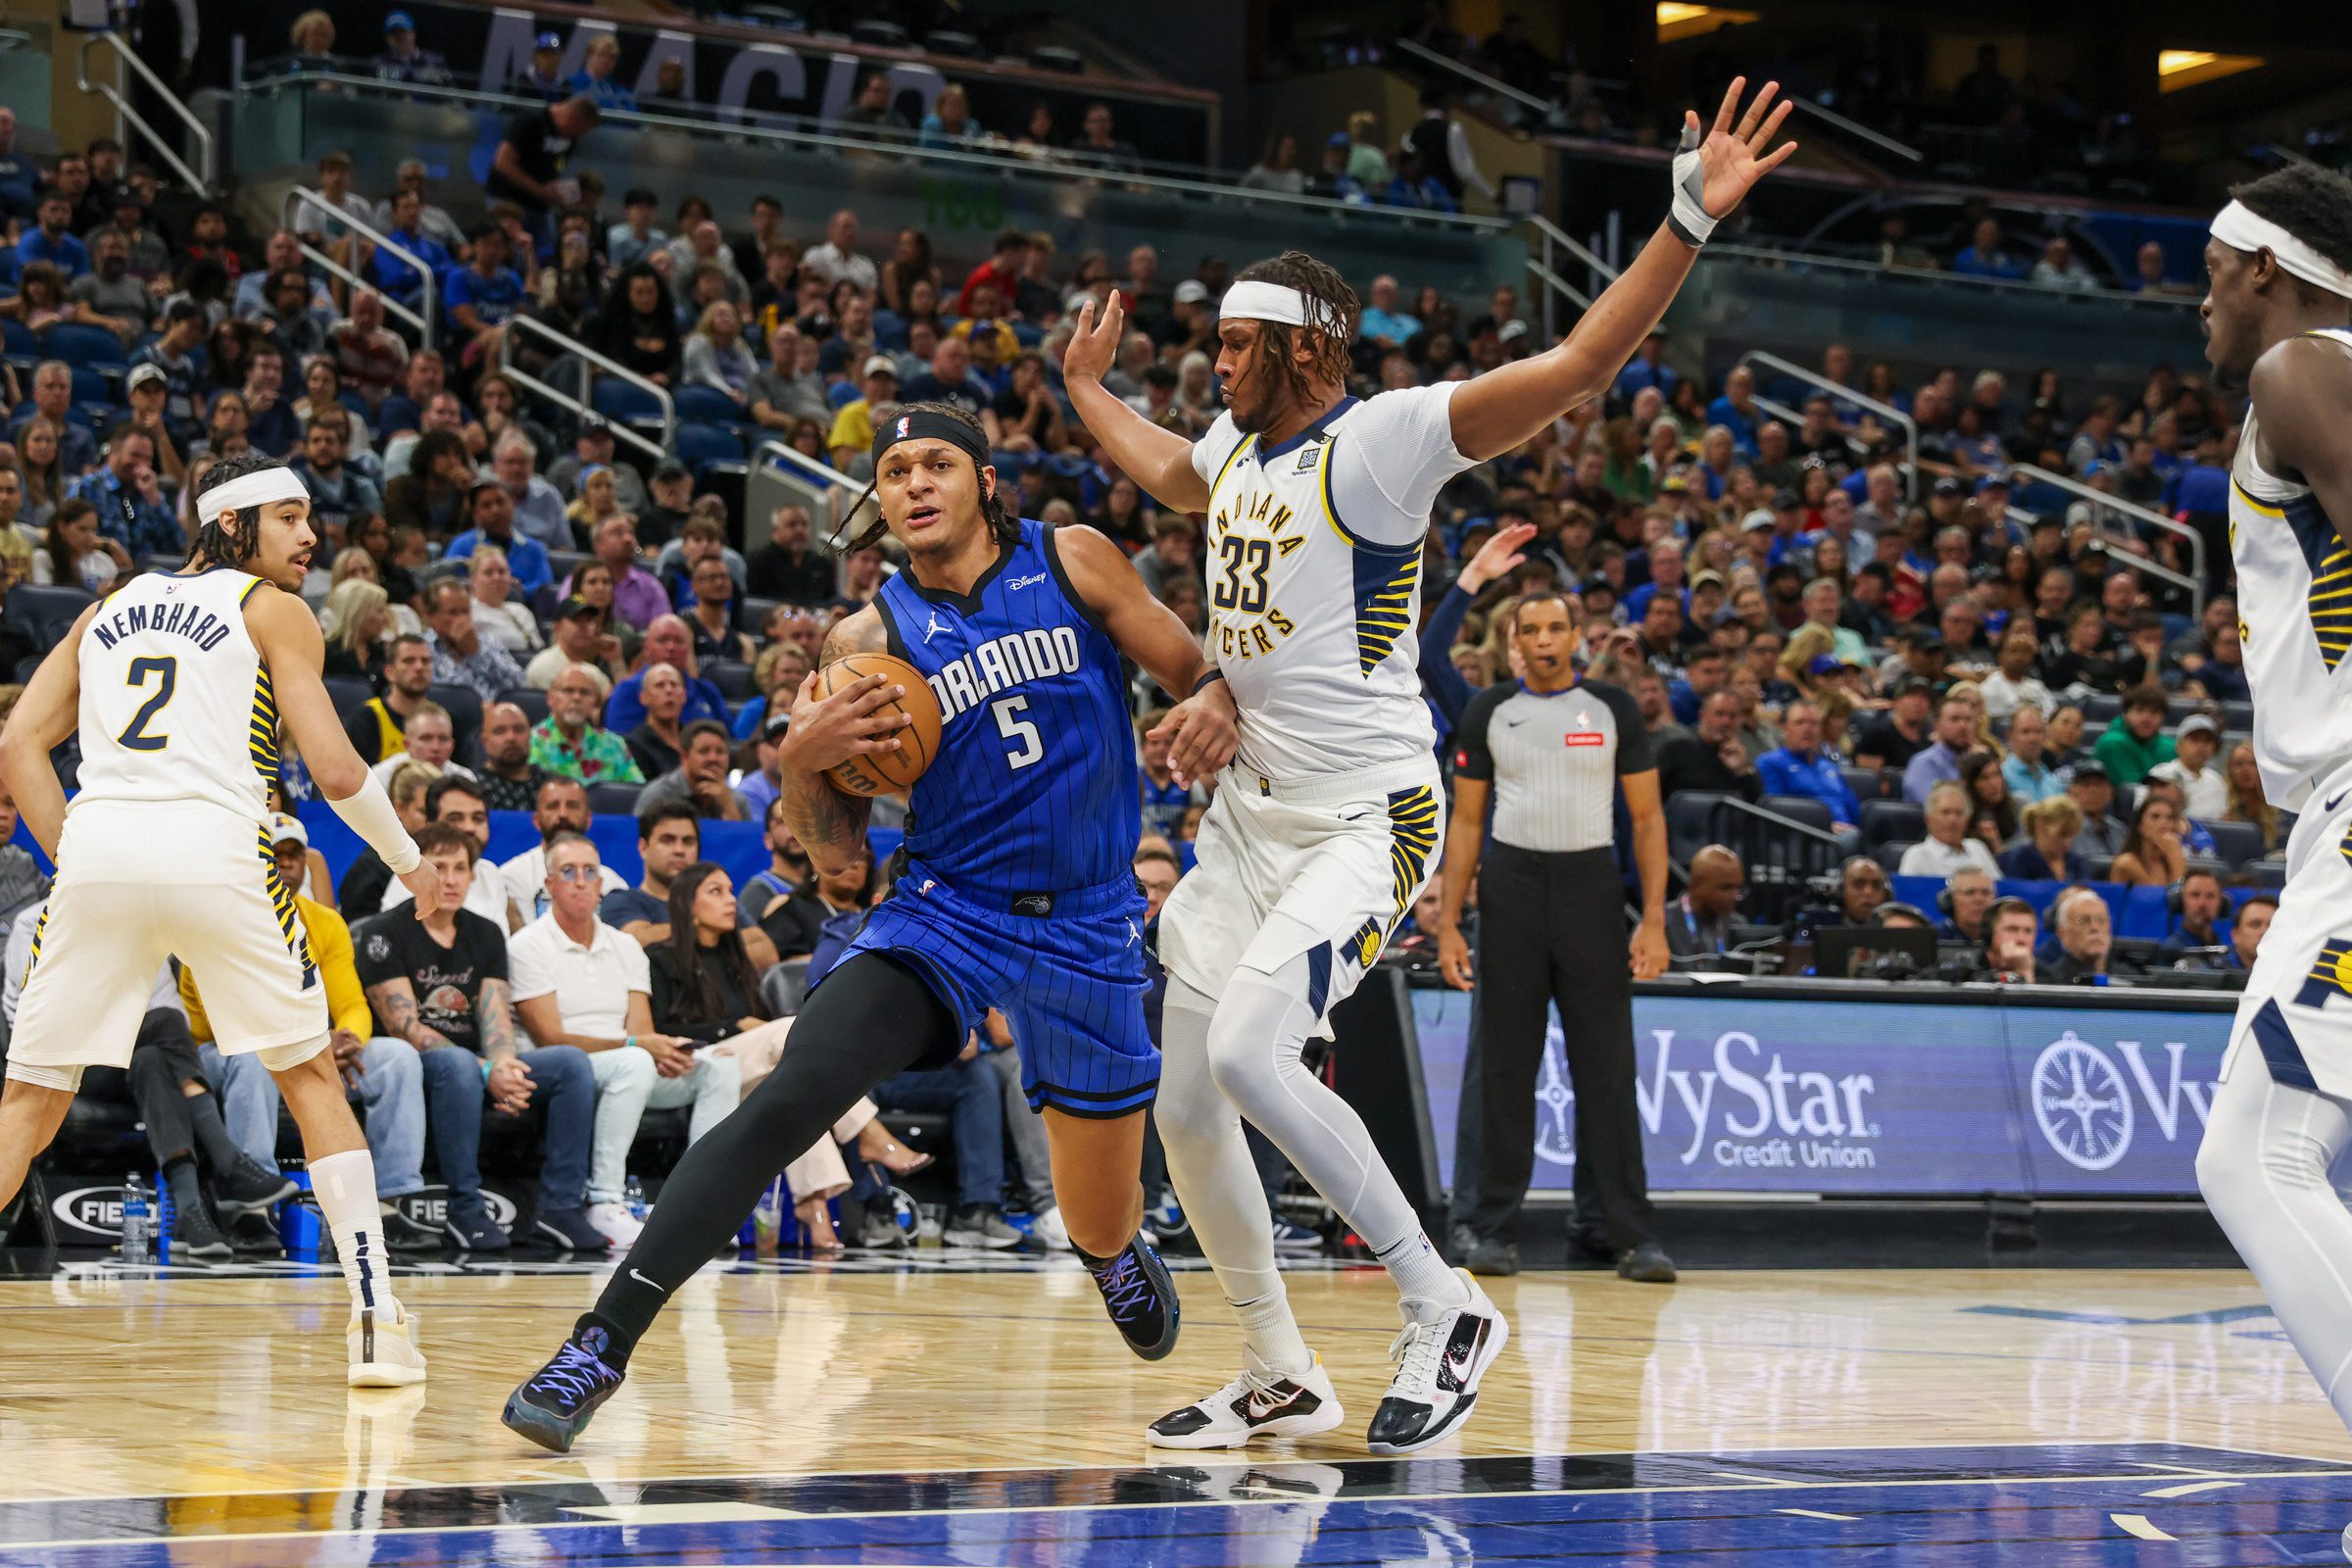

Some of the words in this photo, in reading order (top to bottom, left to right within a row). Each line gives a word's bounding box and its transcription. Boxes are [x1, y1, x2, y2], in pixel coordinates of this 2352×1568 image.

[1208, 491, 1305, 558] INDIANA
[1005, 571, 1047, 591] Disney
[1214, 535, 1271, 614] 33
[93, 603, 230, 652] NEMBHARD
[118, 655, 176, 753] 2
[927, 626, 1079, 726] ORLANDO
[991, 695, 1044, 770] 5
[1635, 1030, 1876, 1165] VyStar
[1714, 1139, 1796, 1167] Credit
[1799, 1140, 1877, 1168] Union
